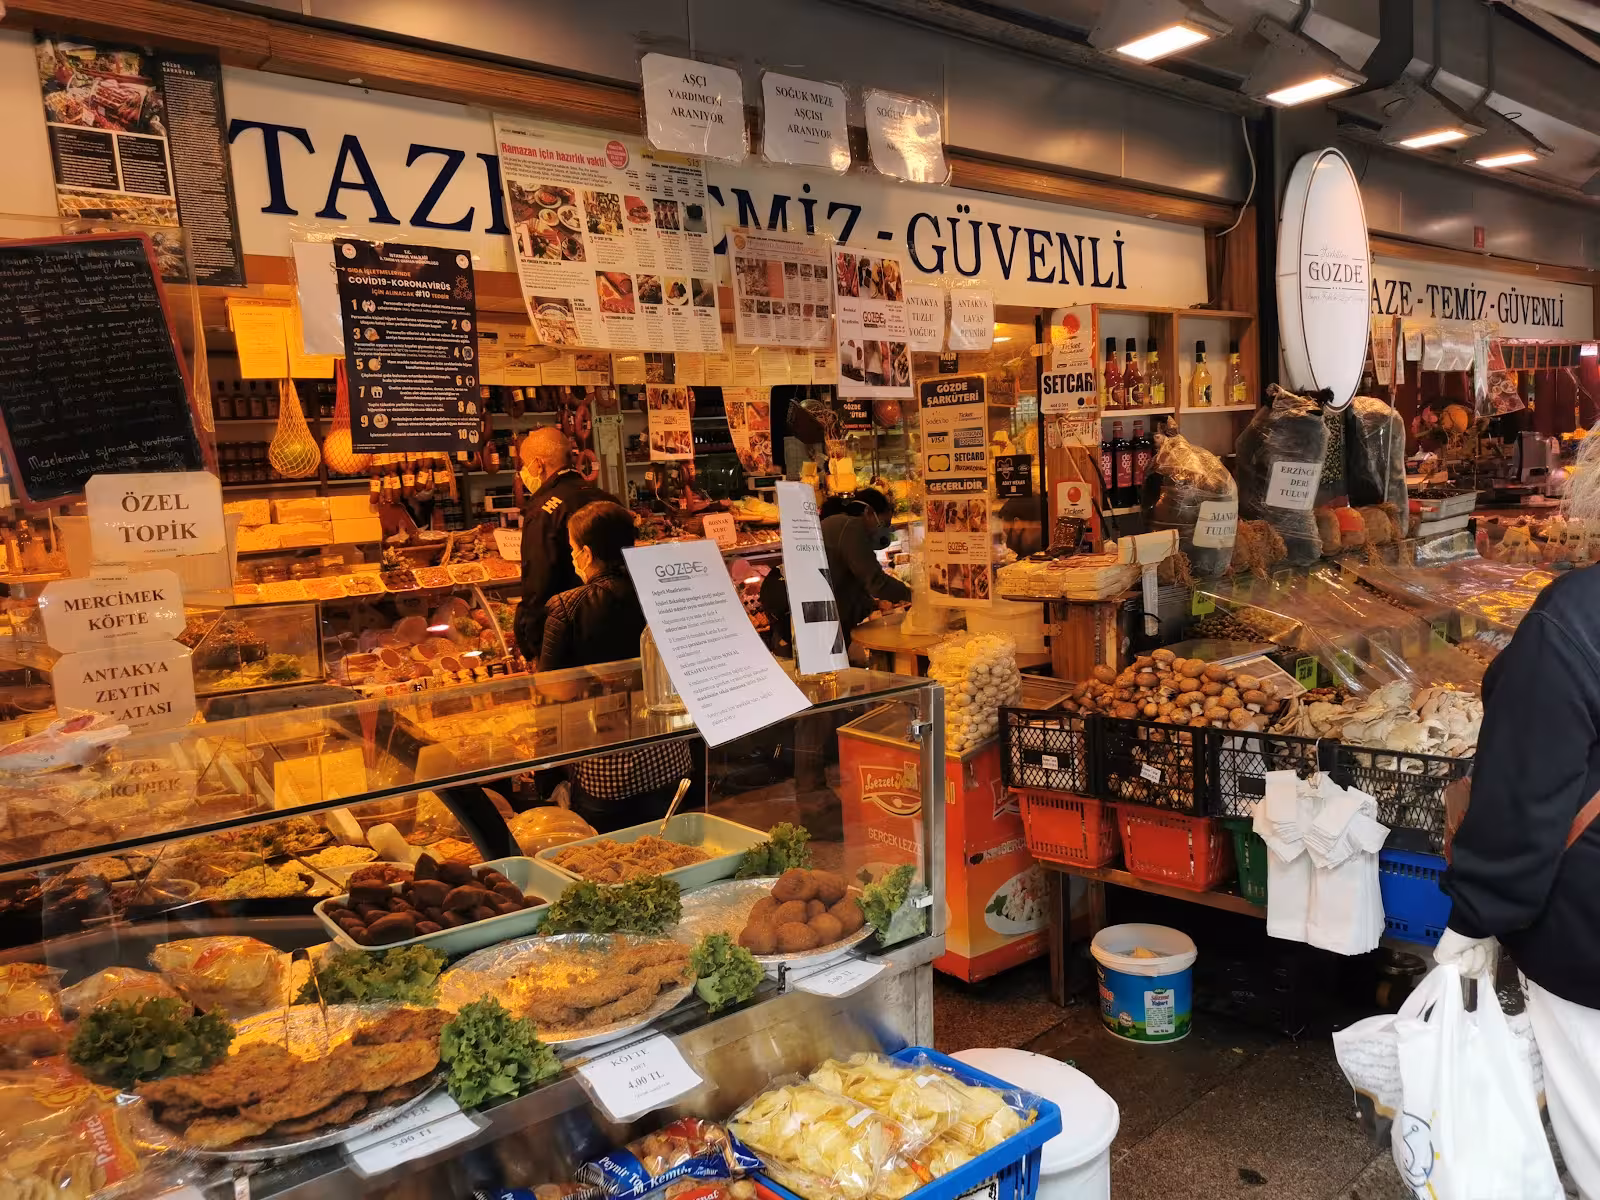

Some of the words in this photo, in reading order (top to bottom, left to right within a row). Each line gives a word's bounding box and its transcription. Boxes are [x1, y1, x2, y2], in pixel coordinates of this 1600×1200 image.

[682, 72, 708, 88] AŞÇI
[775, 85, 808, 101] SOĞUK
[808, 92, 834, 108] MEZE
[670, 106, 724, 124] ARANIYOR
[794, 107, 823, 122] AŞÇISI
[787, 123, 833, 140] ARANIYOR
[501, 142, 538, 158] Ramazan
[538, 147, 555, 160] için
[555, 150, 585, 165] hazırlık
[906, 203, 1128, 289] GÜVENLİ
[348, 275, 451, 291] COVİD19-KORONAVİRÜS
[385, 289, 415, 297] ALINACAK
[415, 290, 430, 298] #10
[905, 297, 939, 308] ANTAKYA
[1370, 278, 1413, 317] AZE
[1497, 287, 1564, 327] GÜVENLİ
[451, 318, 458, 330] 2
[353, 327, 361, 339] 3
[453, 346, 460, 358] 4
[355, 358, 364, 370] 5
[456, 375, 463, 386] 6
[936, 380, 968, 394] GÖZDE
[359, 385, 365, 398] 7
[926, 389, 979, 408] ŞARKÜTERİ
[457, 400, 464, 412] 8
[360, 414, 369, 427] 9
[850, 410, 867, 419] ÜTERİ
[457, 428, 468, 440] 10
[931, 436, 945, 444] VISA
[954, 451, 985, 462] SETCARD
[929, 478, 983, 493] GEÇERLİDİR
[121, 491, 191, 514] ÖZEL
[118, 520, 199, 545] TOPİK
[63, 588, 166, 613] MERCİMEK
[88, 611, 149, 631] KÖFTE
[82, 661, 169, 684] ANTAKYA
[95, 681, 161, 704] ZEYTİN
[864, 773, 895, 791] Lezzet
[868, 828, 898, 847] GERÇEK
[898, 837, 922, 856] LEZZE
[648, 1070, 665, 1082] TL
[598, 1156, 629, 1178] Peynir
[628, 1172, 644, 1190] To
